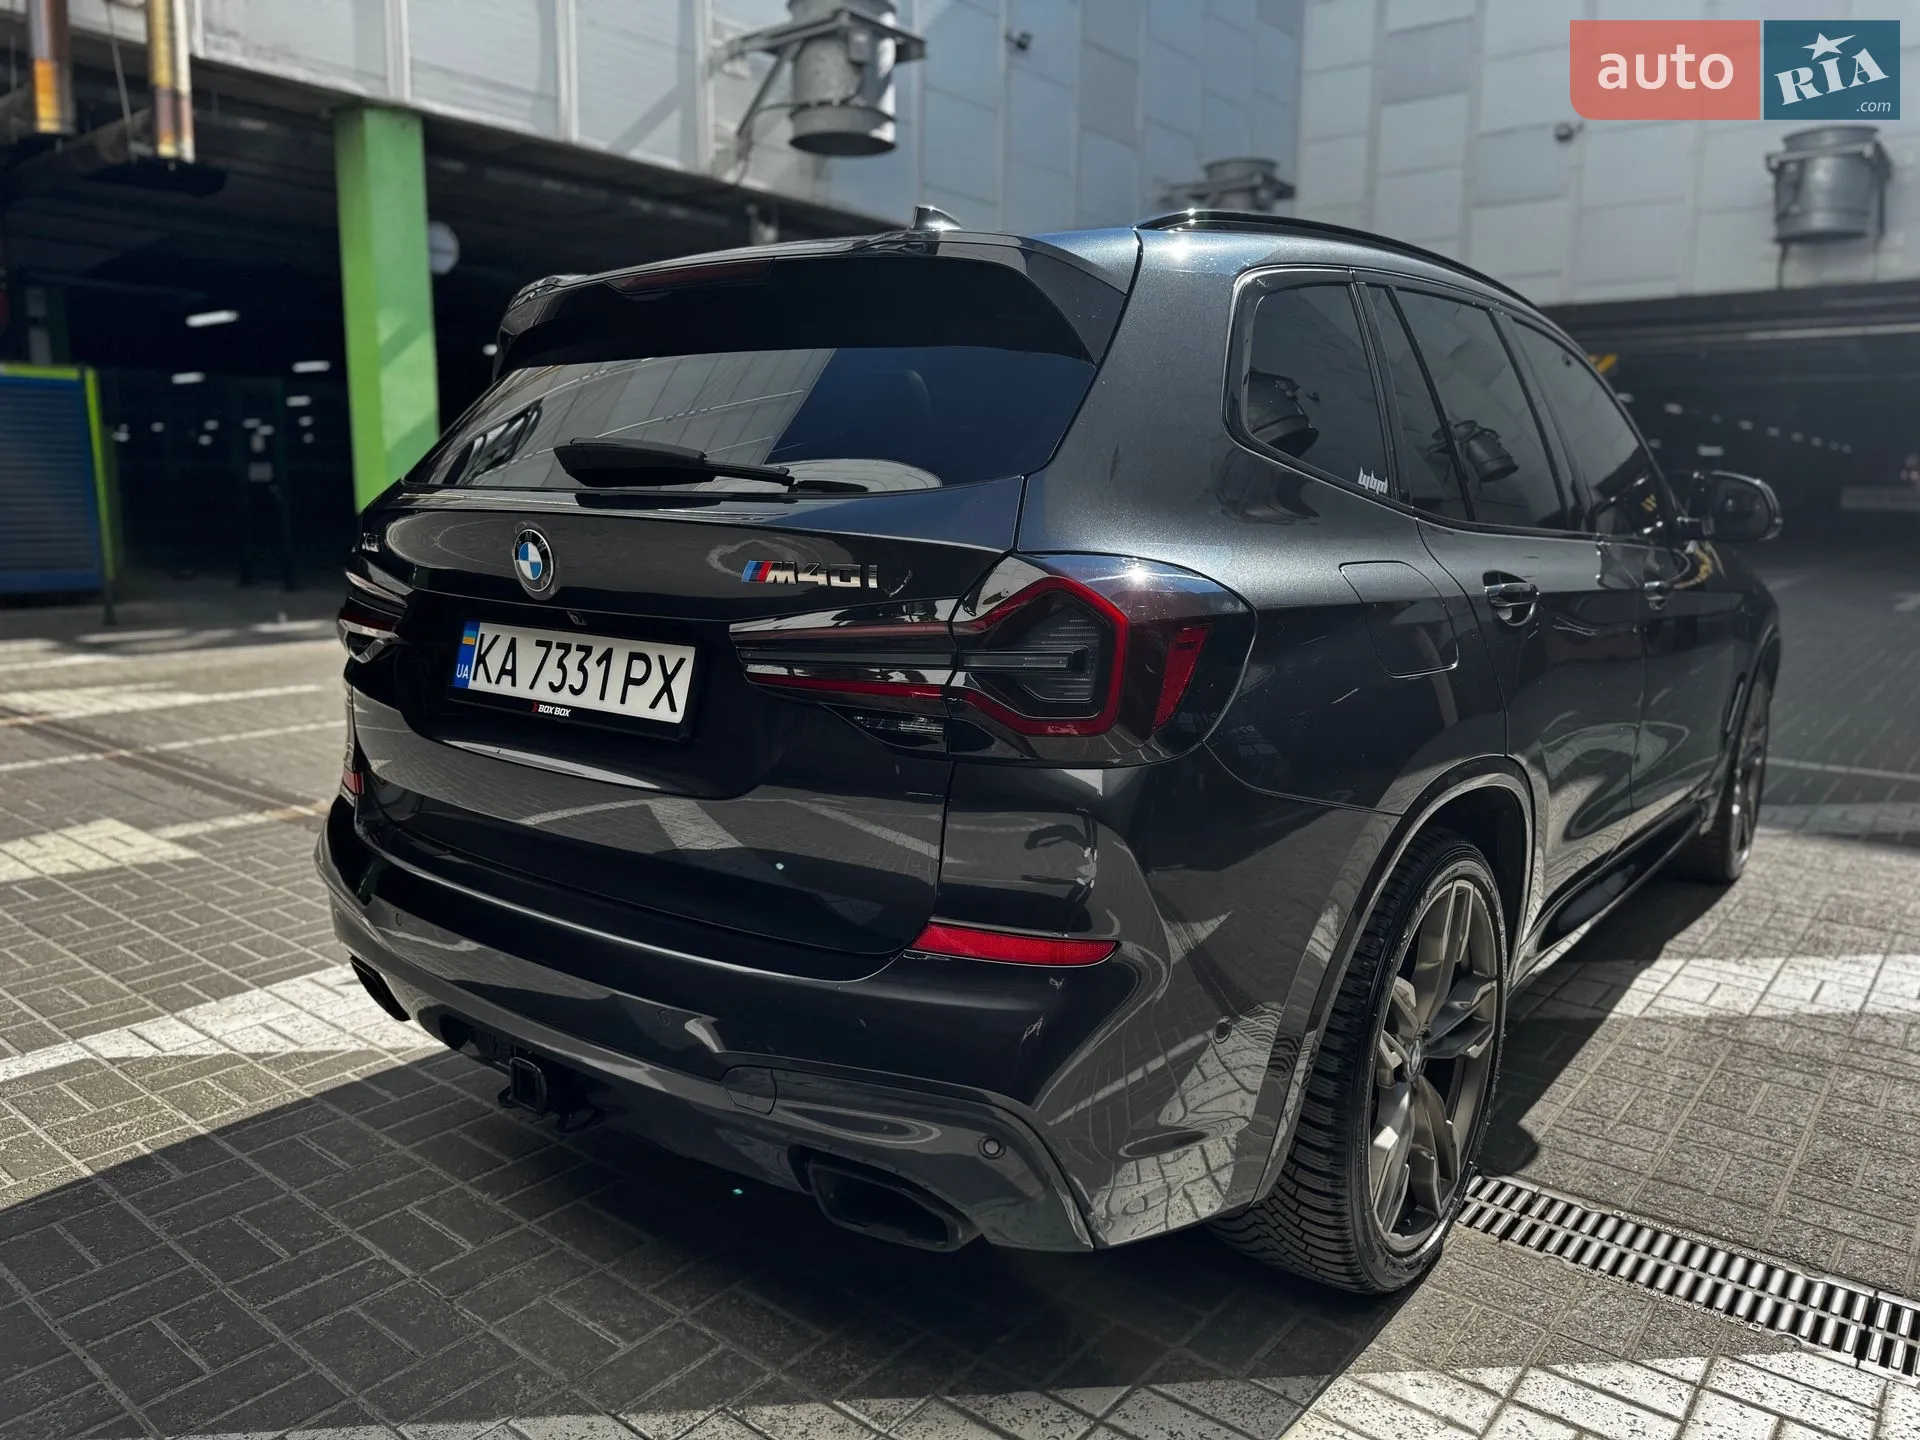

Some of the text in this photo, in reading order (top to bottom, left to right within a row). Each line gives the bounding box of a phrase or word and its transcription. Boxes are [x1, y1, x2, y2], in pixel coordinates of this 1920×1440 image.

[764, 560, 878, 588] M40i
[456, 663, 469, 679] UA
[472, 633, 687, 712] KA 7331 PX
[538, 704, 571, 717] BOX BOX
[1642, 1287, 1744, 1327] STANDARTPARK
